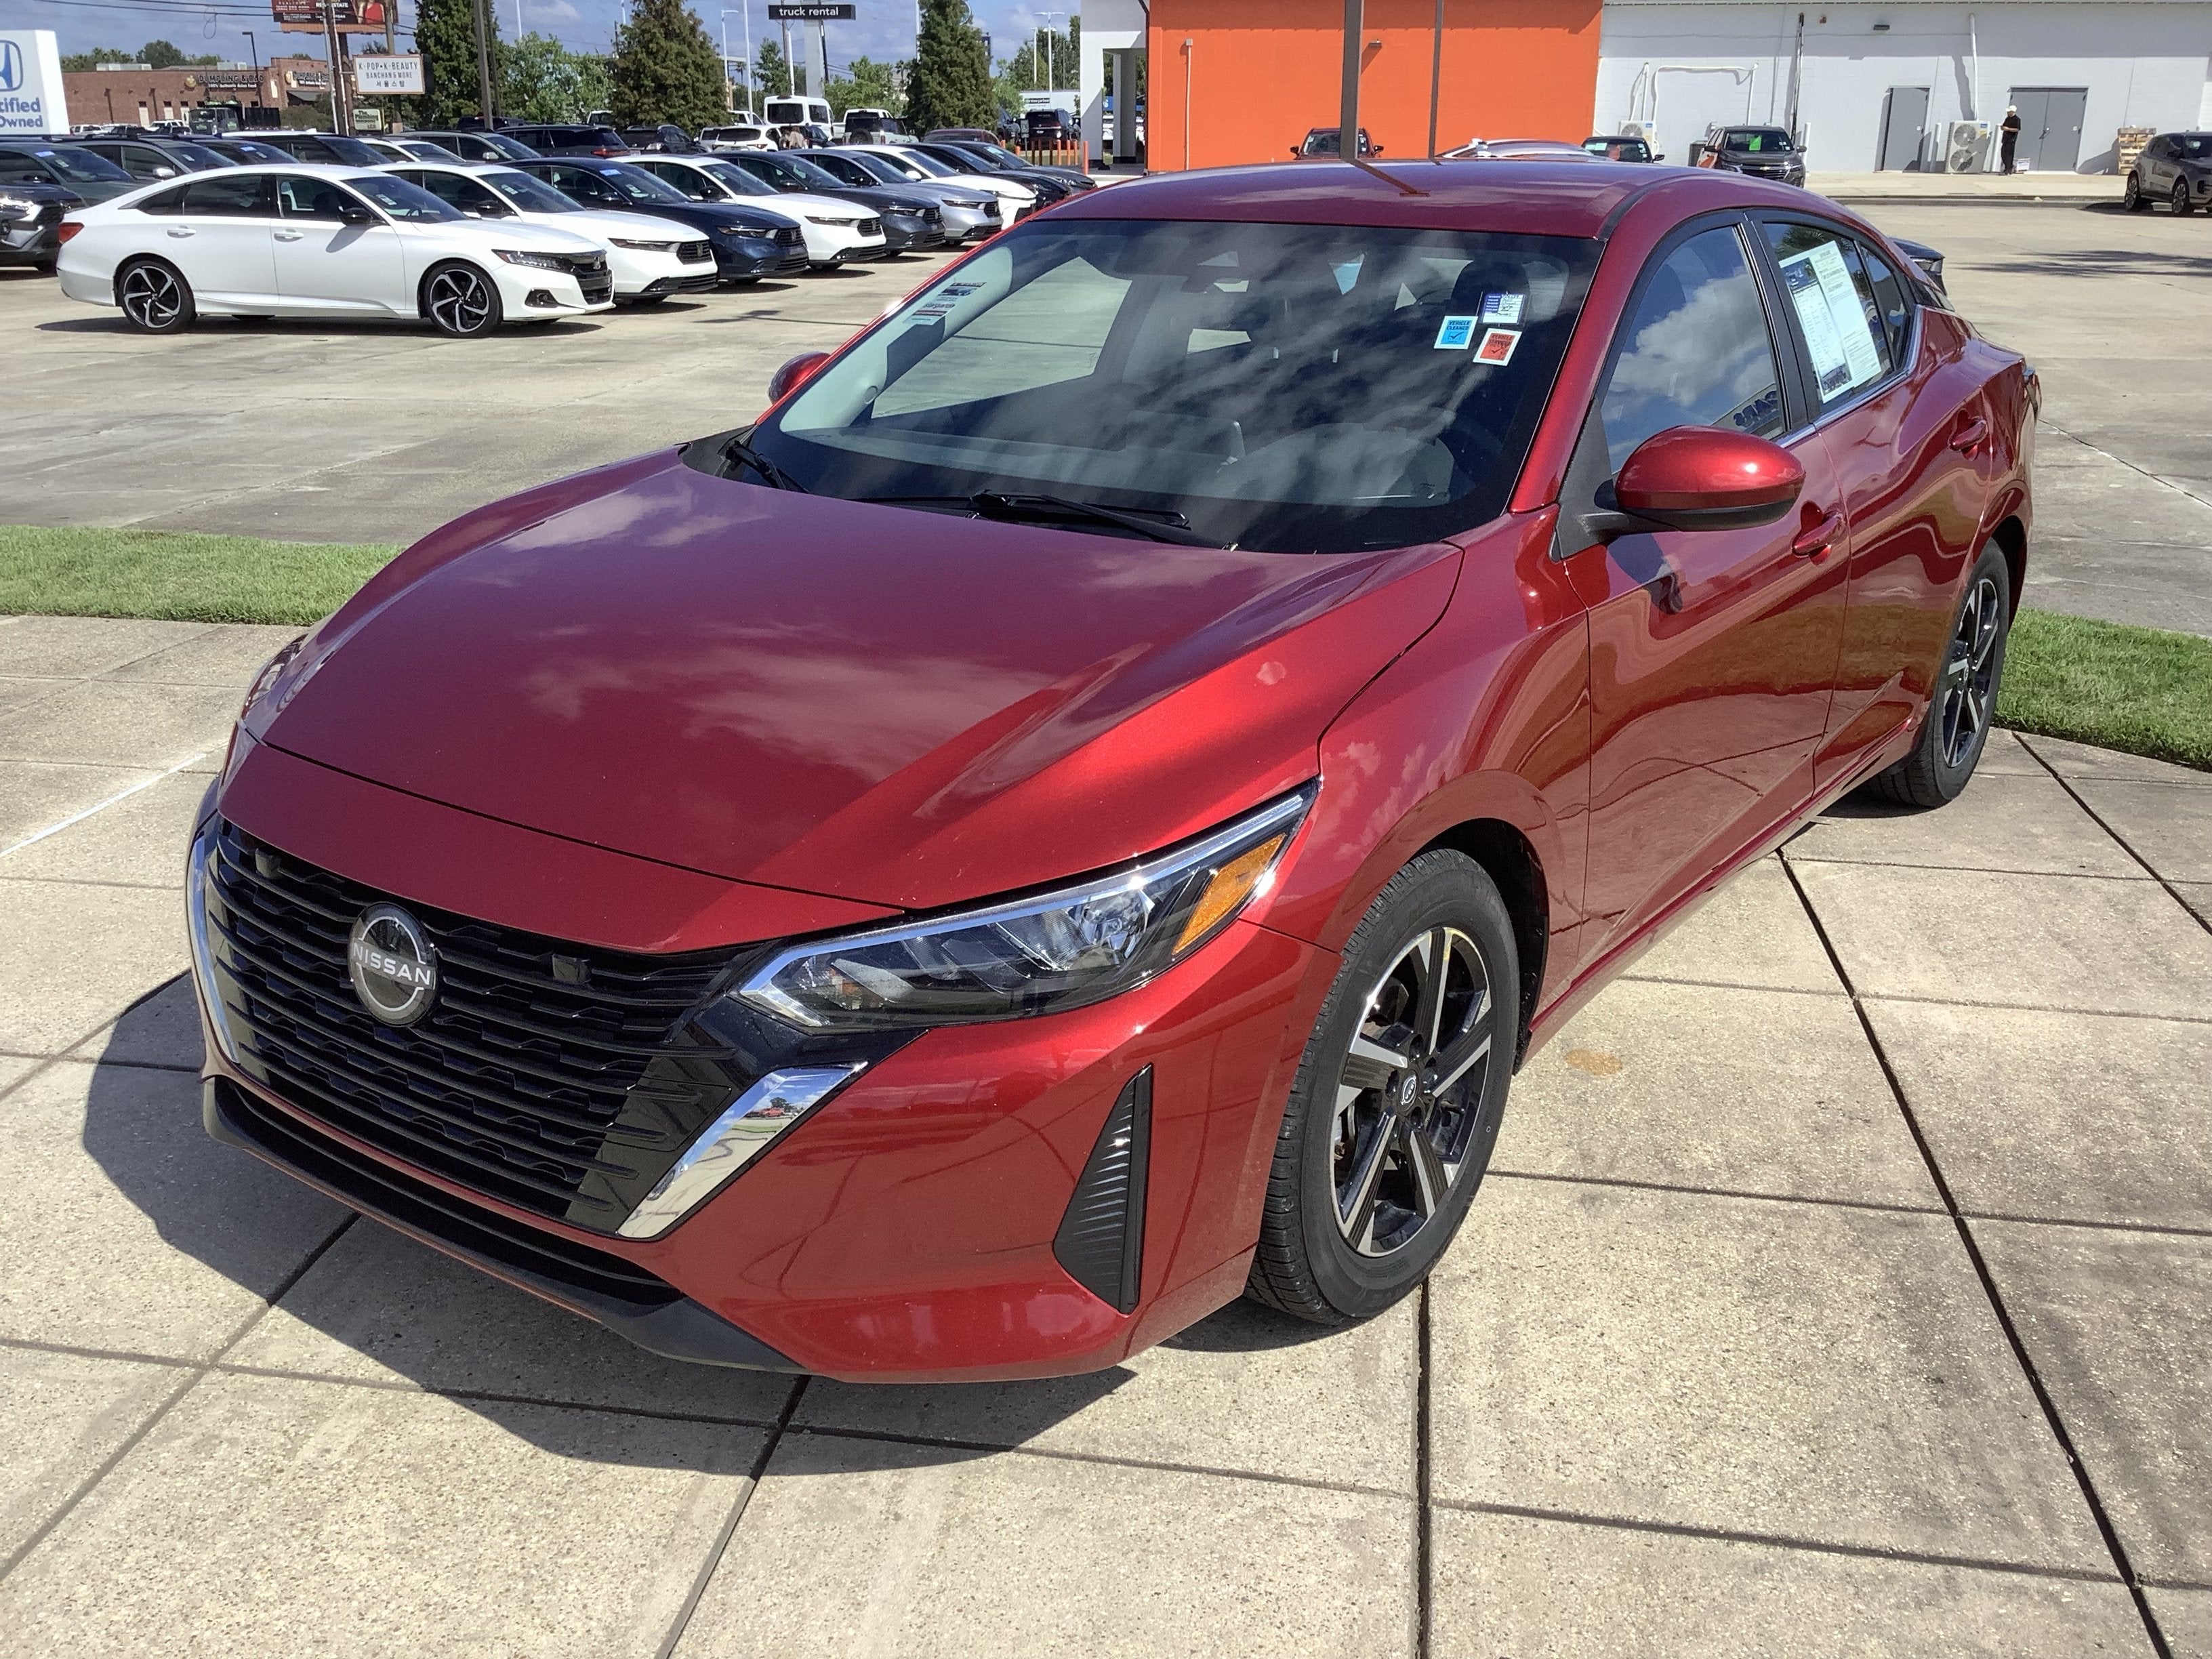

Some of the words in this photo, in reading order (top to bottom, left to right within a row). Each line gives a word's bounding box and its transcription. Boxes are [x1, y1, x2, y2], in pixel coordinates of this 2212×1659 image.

[779, 7, 805, 16] truck
[808, 7, 839, 16] rental
[353, 942, 431, 985] NISSAN
